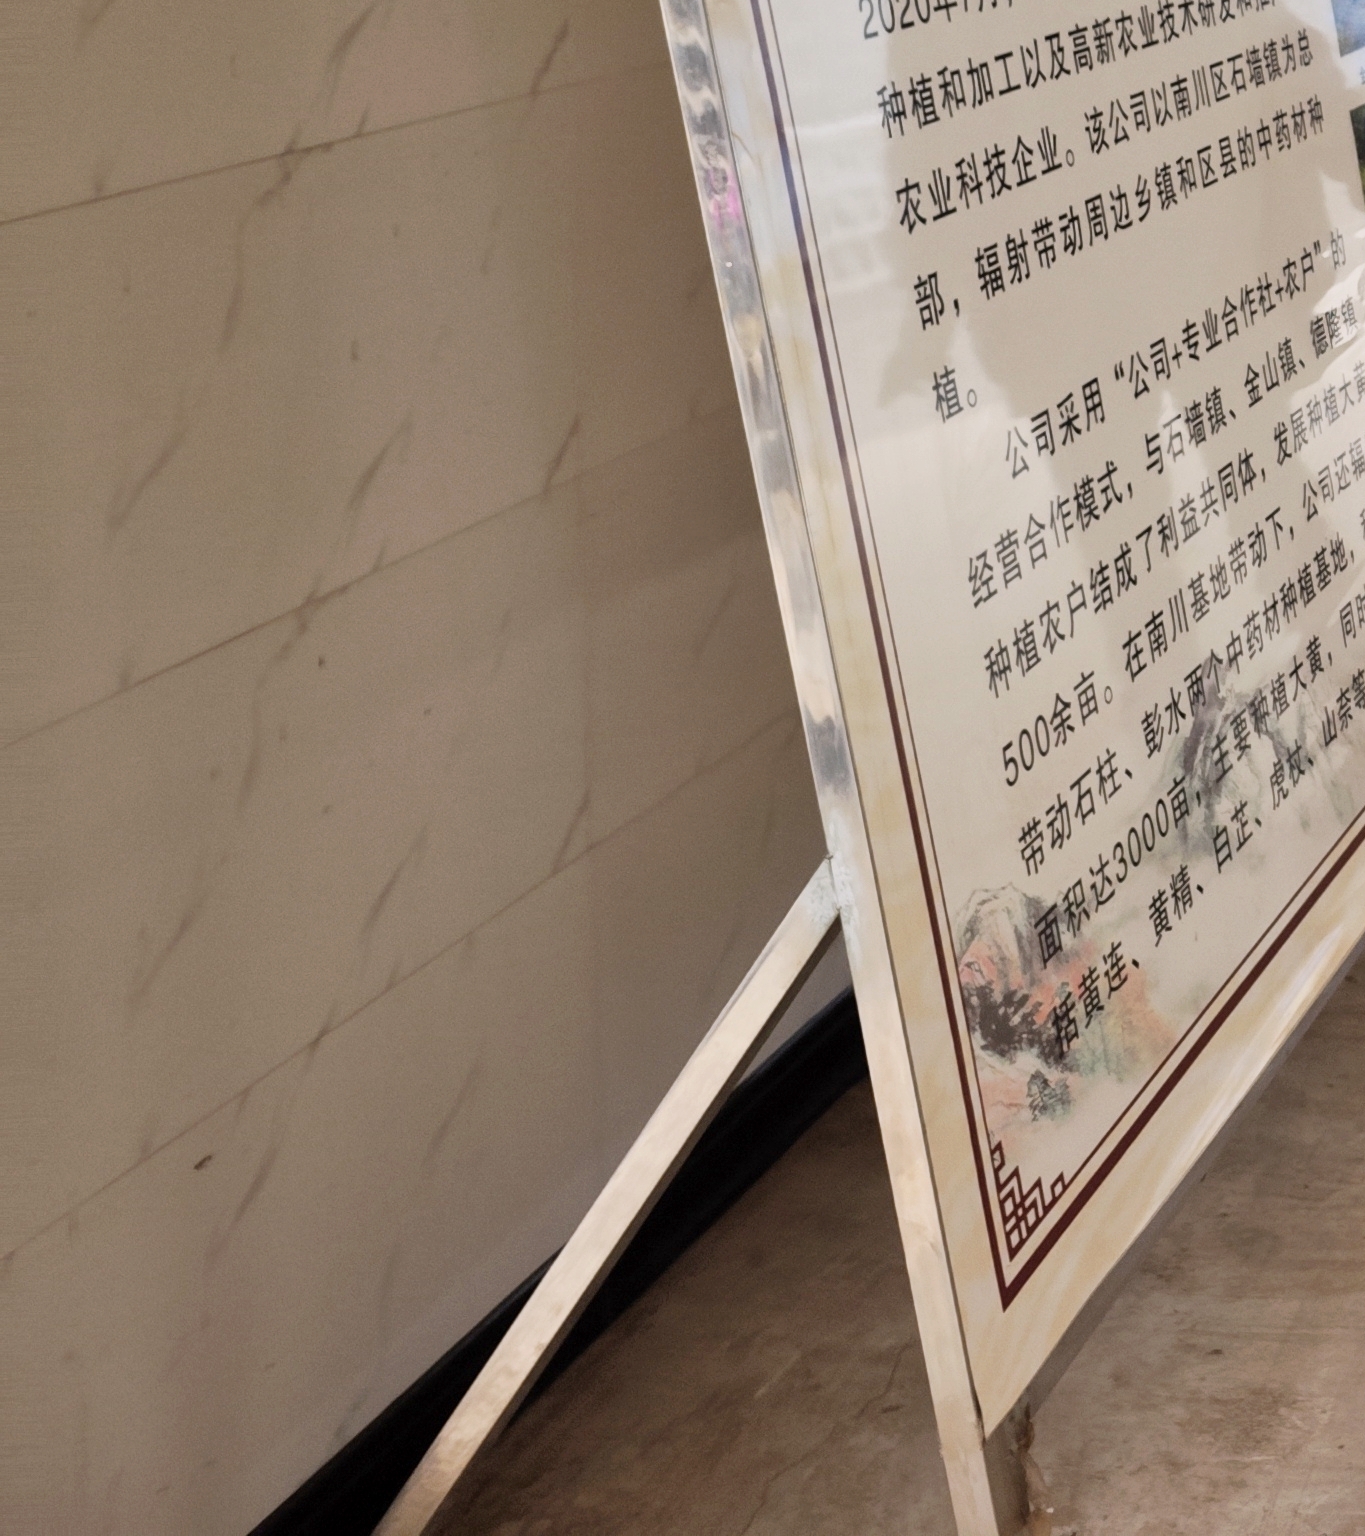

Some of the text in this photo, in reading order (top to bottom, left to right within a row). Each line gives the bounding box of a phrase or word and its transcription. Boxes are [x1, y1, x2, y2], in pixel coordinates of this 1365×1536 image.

[893, 26, 1314, 237] 农业科技企业。该公司以南川区石墙镇为总
[911, 92, 1326, 333] 部，辐射带动周边乡镇和区县的中药材种
[929, 355, 977, 426] 植。
[964, 293, 1359, 613] 经营合作模式，与石墙镇、金山镇、德隆镇
